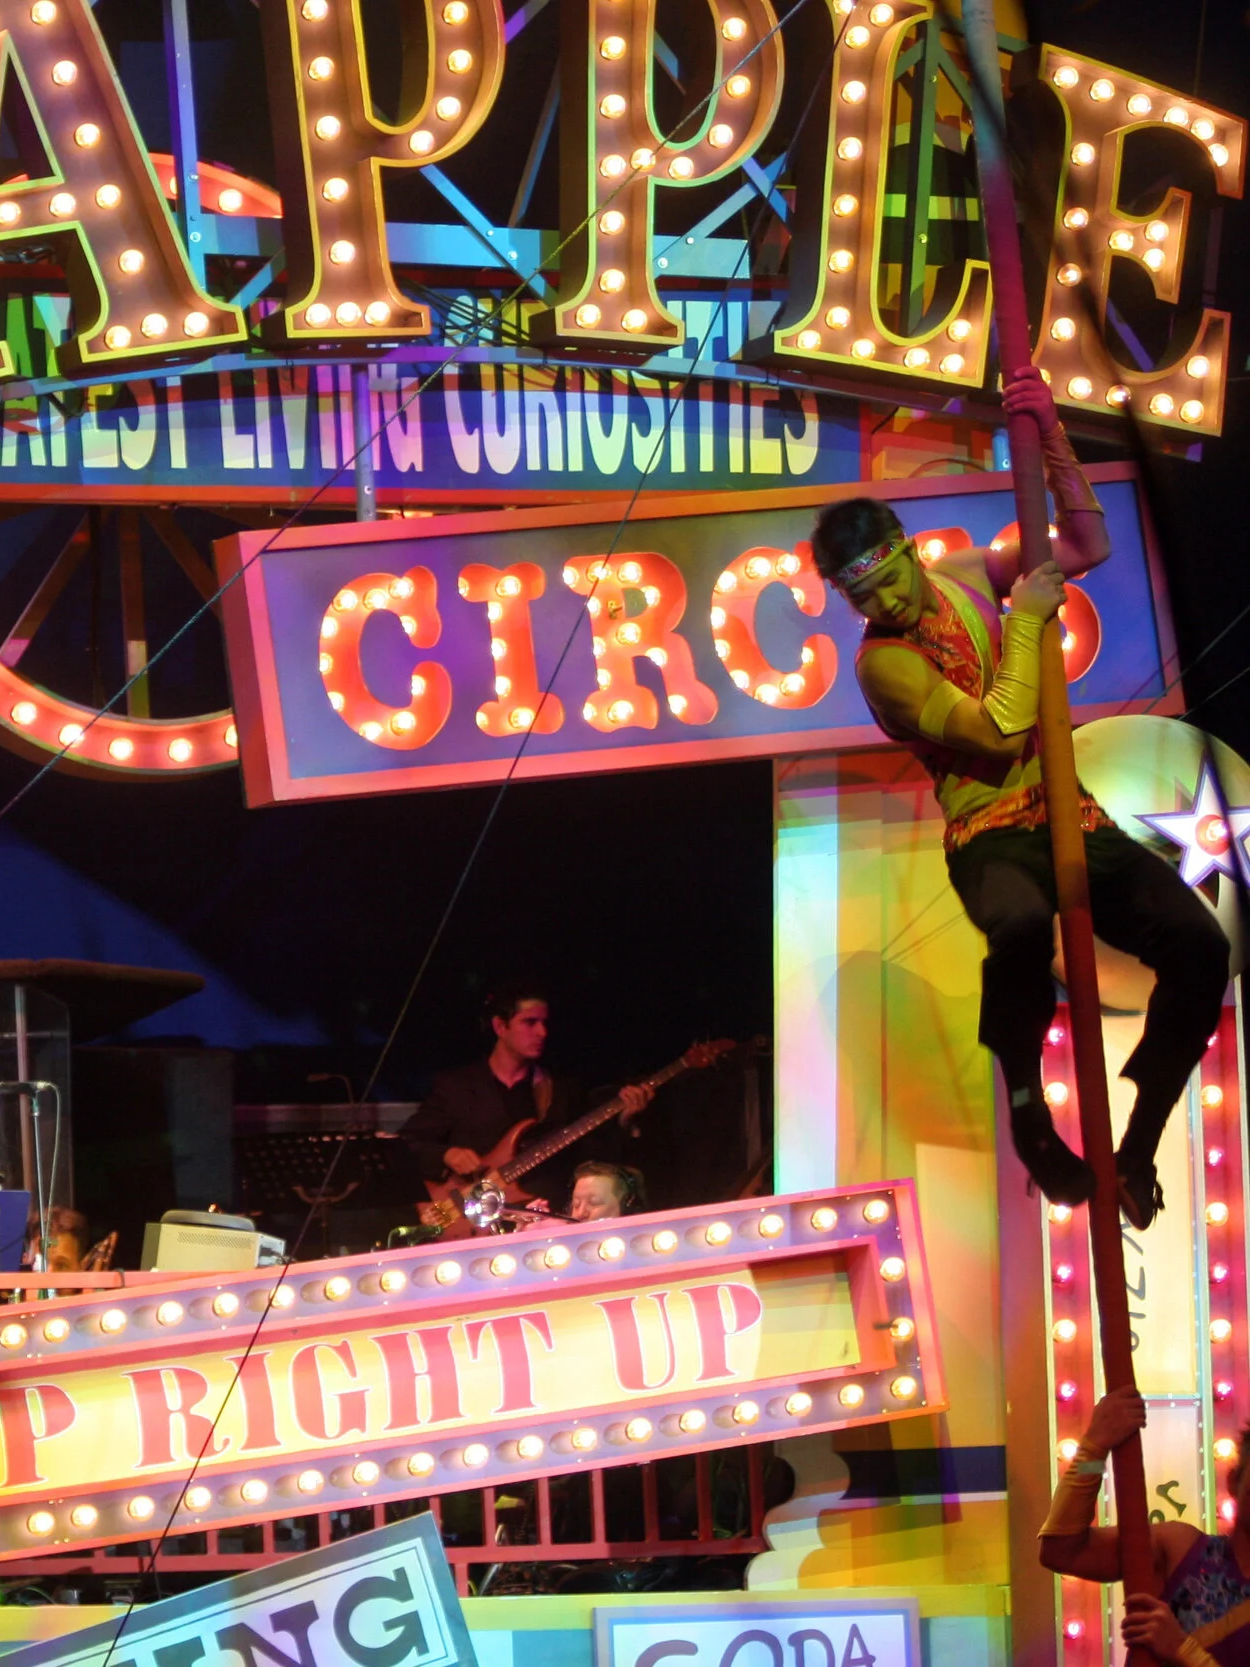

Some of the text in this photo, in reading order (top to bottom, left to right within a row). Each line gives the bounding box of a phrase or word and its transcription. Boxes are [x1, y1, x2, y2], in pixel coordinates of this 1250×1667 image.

[318, 520, 1102, 752] CIRC
[121, 1310, 554, 1470] RIGHT
[595, 1281, 763, 1393] UP
